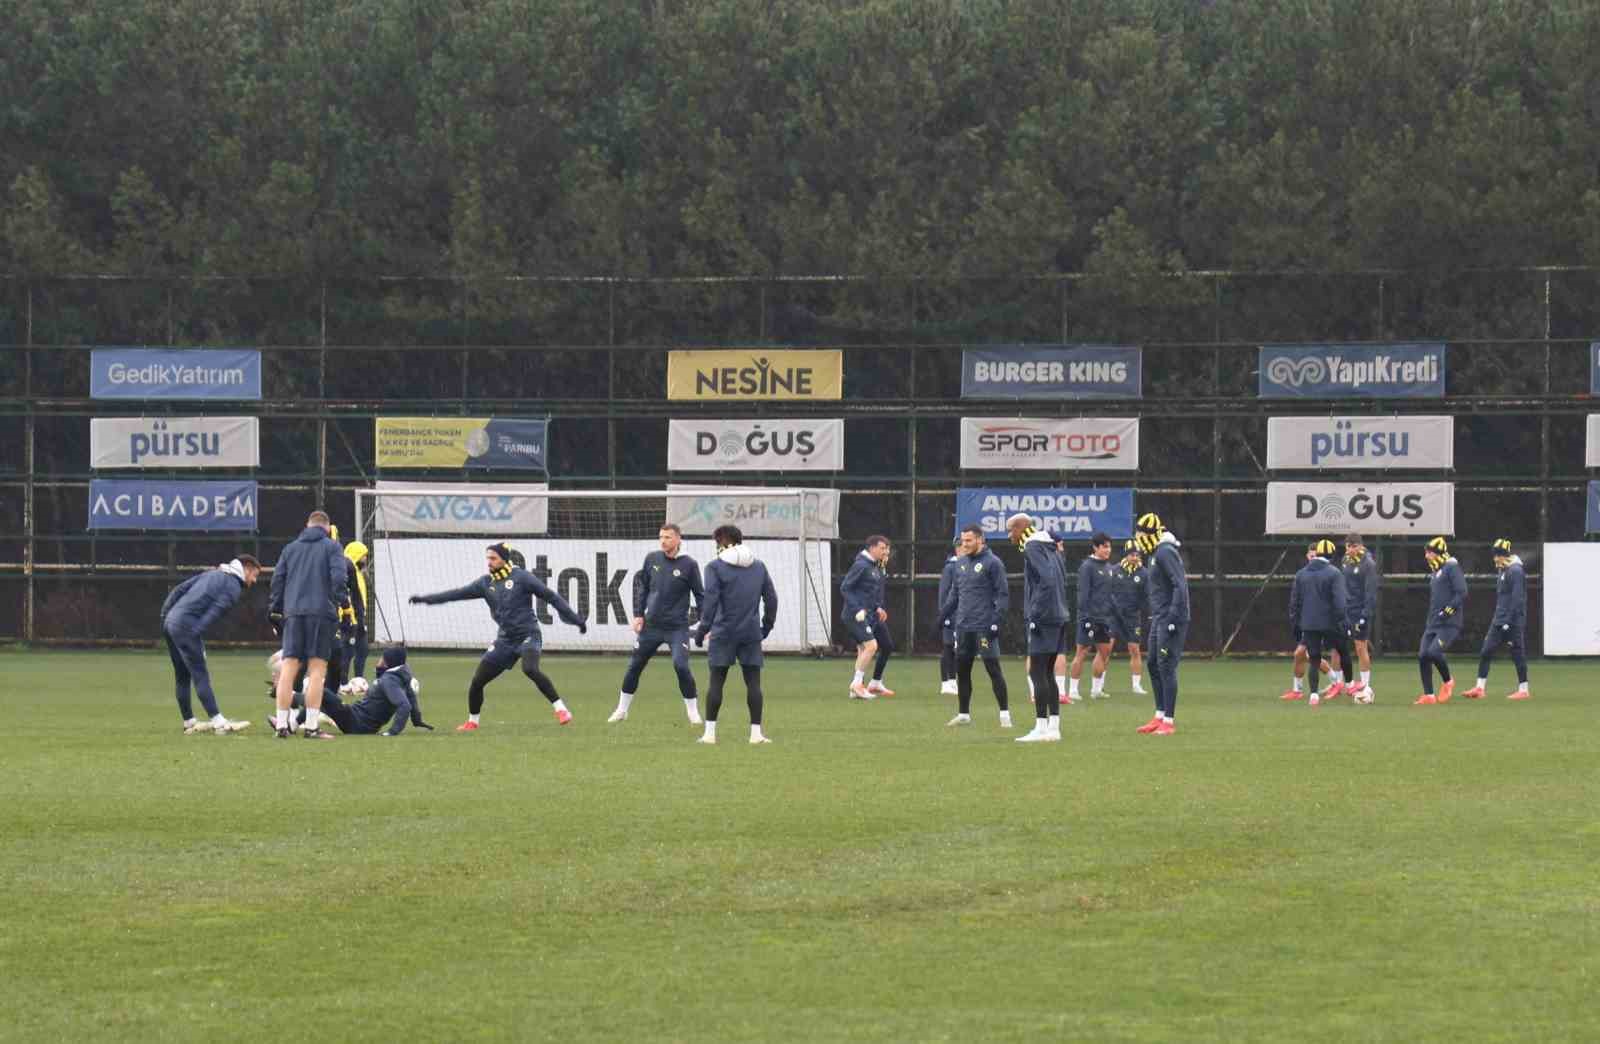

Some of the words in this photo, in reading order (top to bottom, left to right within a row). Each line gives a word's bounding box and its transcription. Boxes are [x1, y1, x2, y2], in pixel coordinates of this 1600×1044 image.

[974, 361, 1064, 382] BURGER
[1070, 361, 1127, 382] KING
[1326, 355, 1438, 387] YapıKredi
[130, 421, 219, 463] pürsu
[1311, 421, 1409, 465] pürsu
[92, 493, 254, 516] ACIBADEM
[415, 495, 512, 520] AYGAZ
[982, 495, 1107, 511] ANADOLU
[981, 512, 1092, 532] SİORTA
